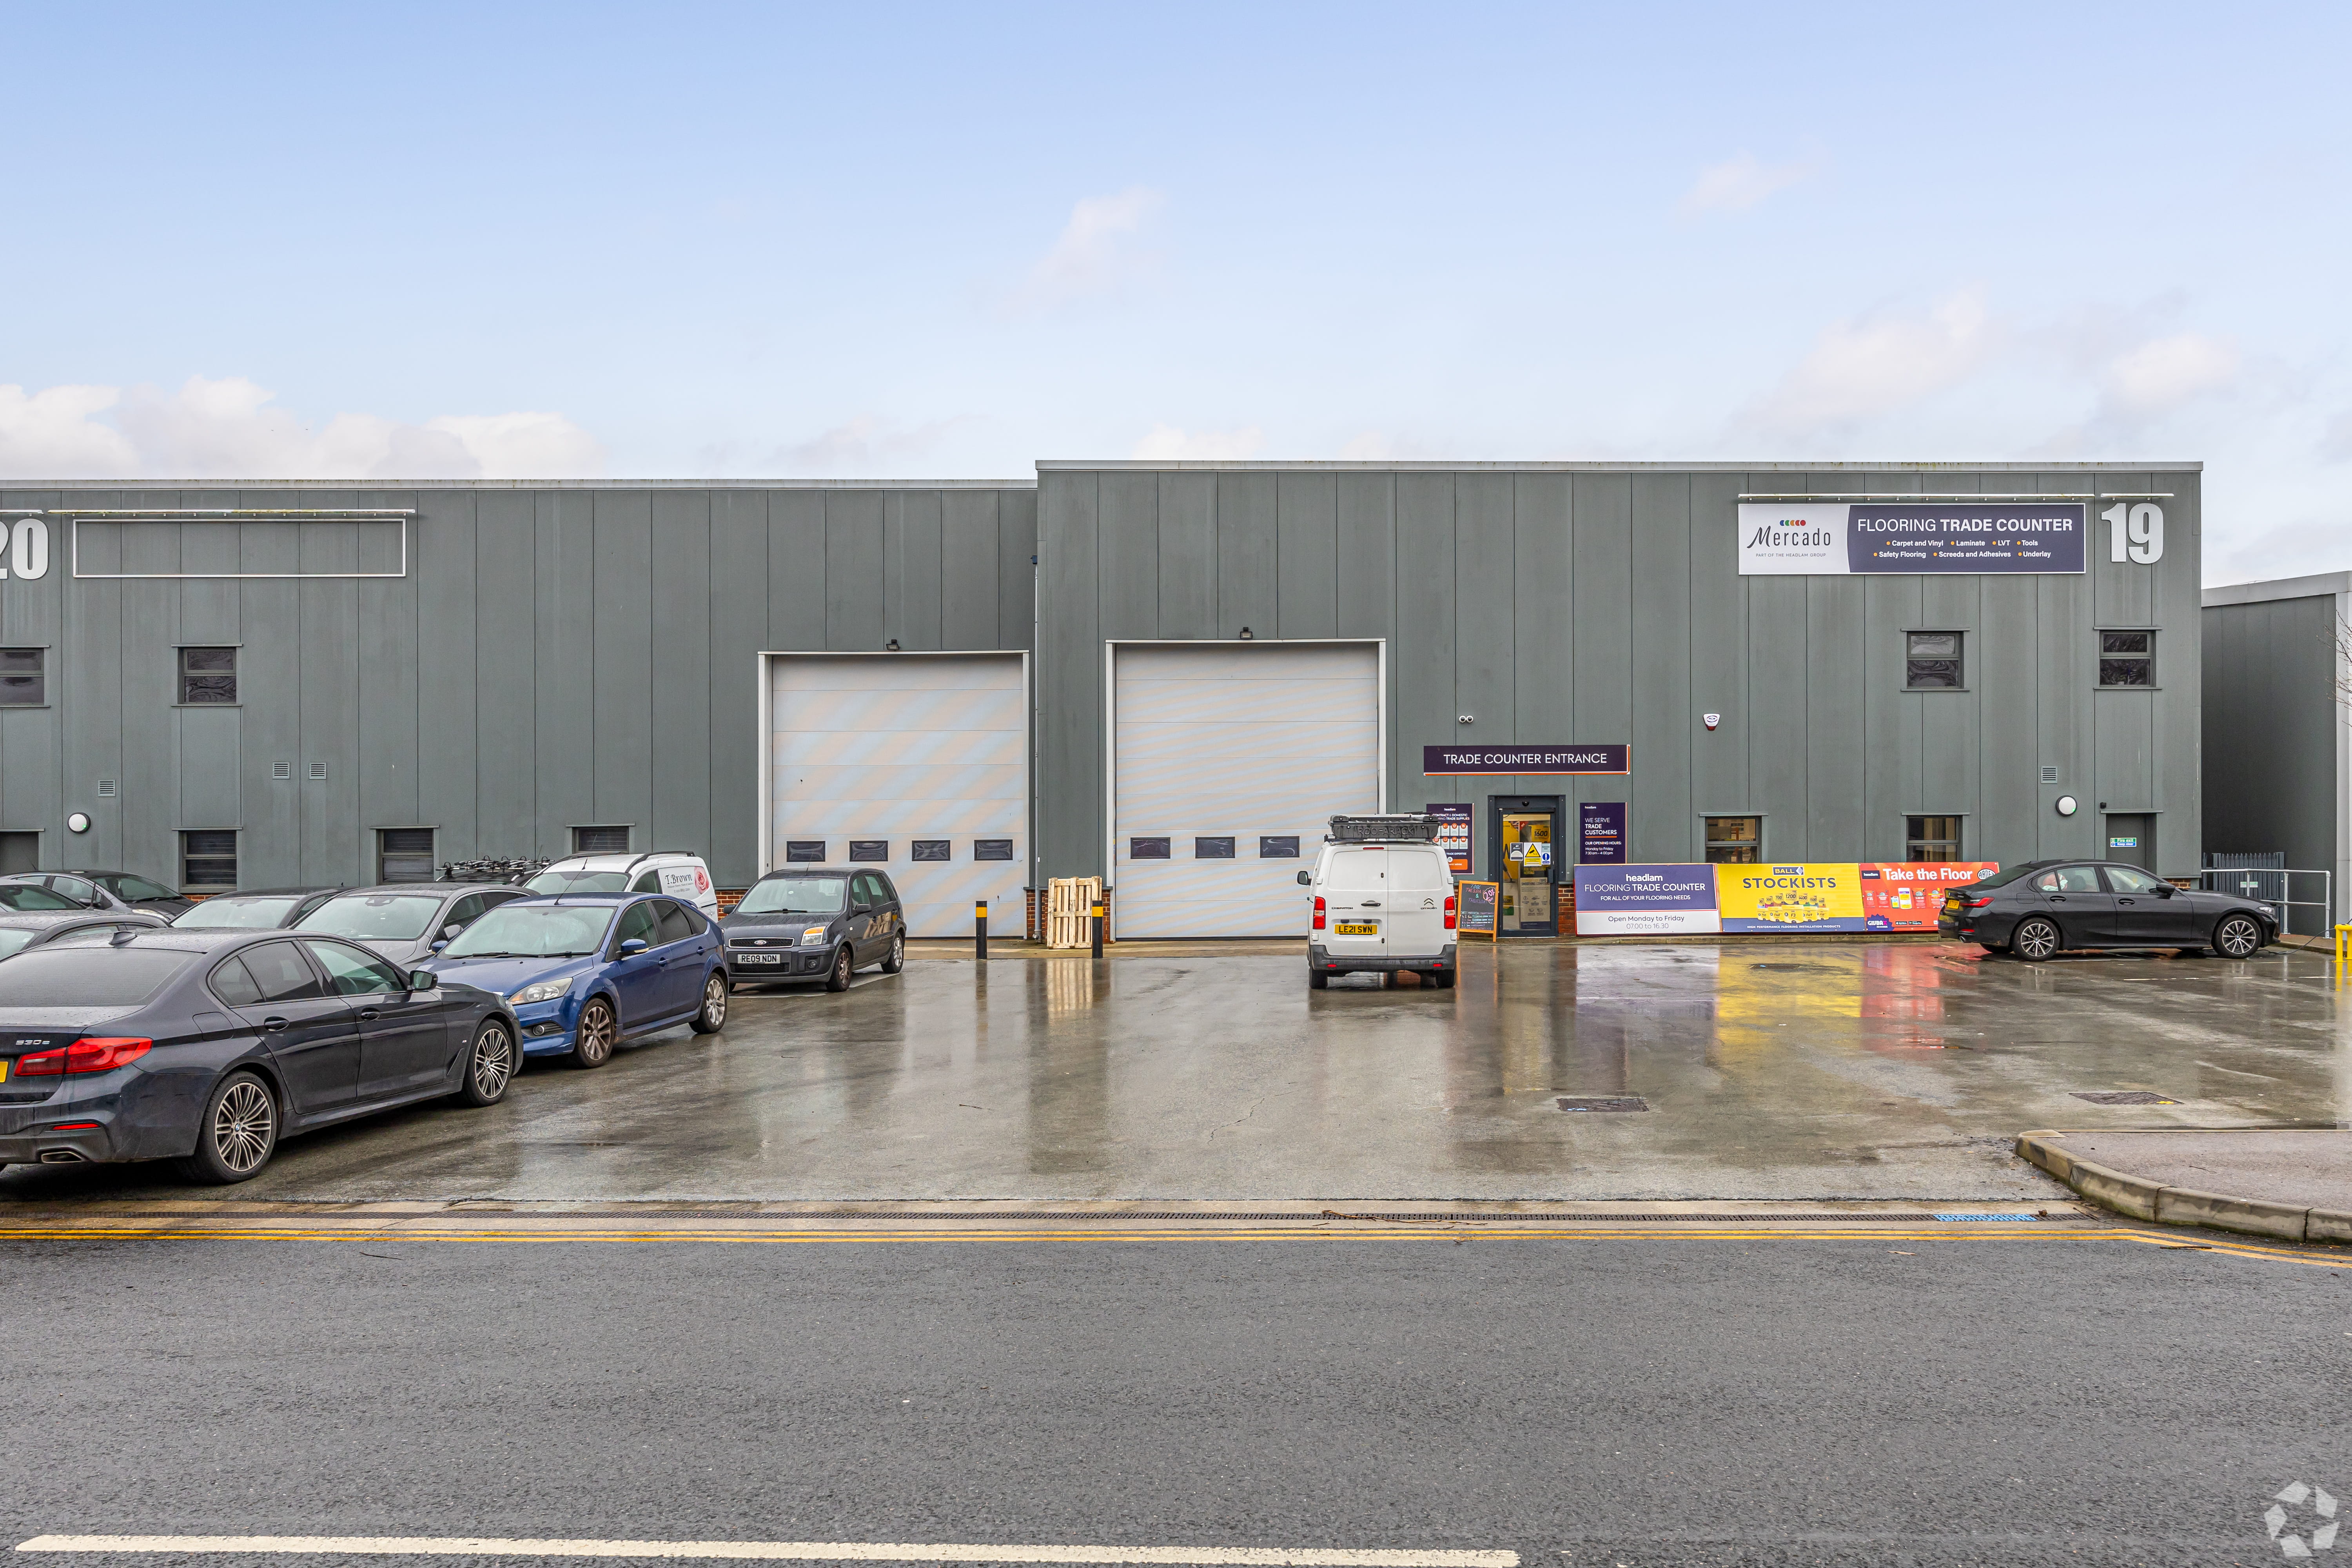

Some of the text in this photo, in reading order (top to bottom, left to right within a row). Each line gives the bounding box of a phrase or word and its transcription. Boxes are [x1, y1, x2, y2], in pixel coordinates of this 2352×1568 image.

[1858, 518, 2073, 532] FLOORING TRADE COUNTER
[1746, 525, 1831, 548] Mercado
[2101, 502, 2163, 564] 19
[0, 518, 48, 579] 0
[1444, 753, 1607, 764] TRADE COUNTER ENTRANCE
[1625, 873, 1663, 882] headlam
[1883, 868, 1973, 880] Take the Floor
[1584, 884, 1631, 892] FLOORING
[1743, 877, 1836, 889] STOCKISTS
